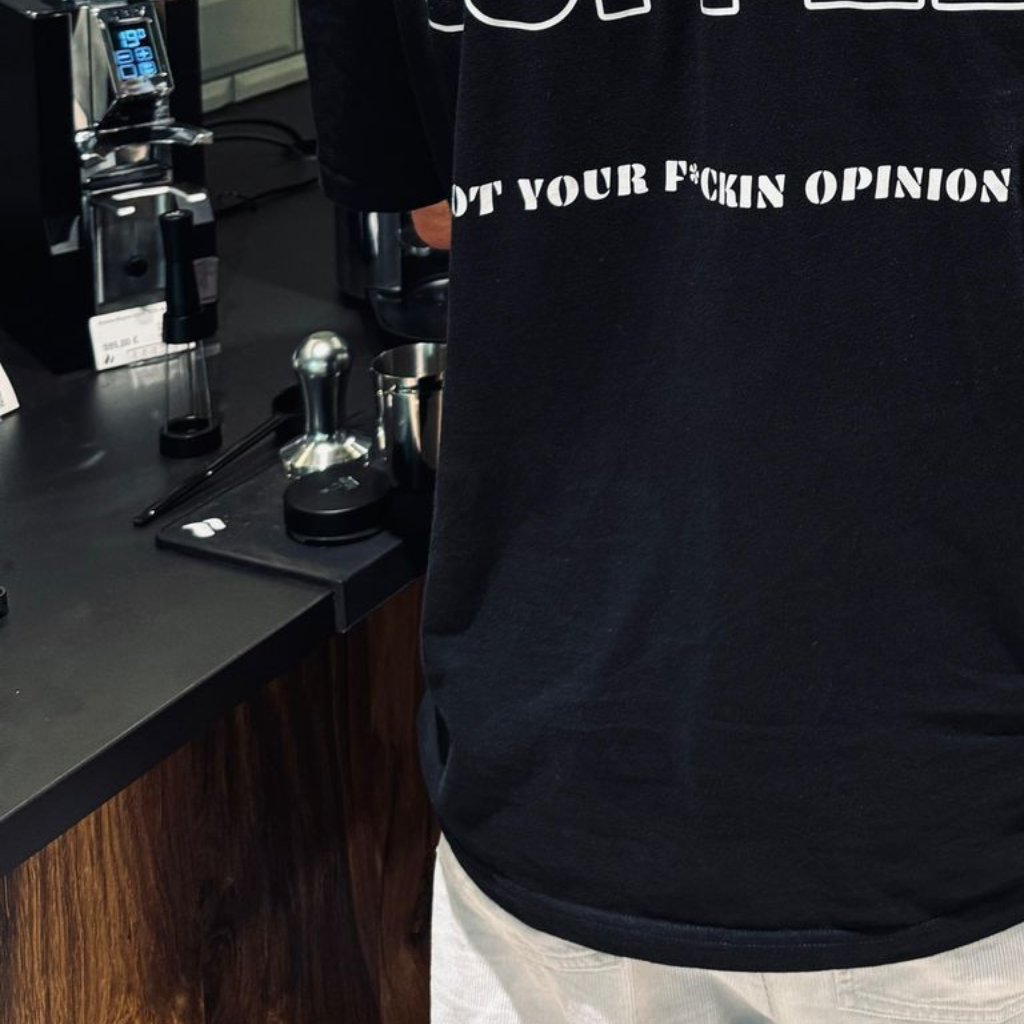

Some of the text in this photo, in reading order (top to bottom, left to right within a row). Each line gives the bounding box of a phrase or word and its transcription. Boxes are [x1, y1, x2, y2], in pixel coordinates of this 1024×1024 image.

[452, 180, 501, 218] OT
[517, 163, 649, 211] YOUR
[804, 165, 1011, 205] OPINION
